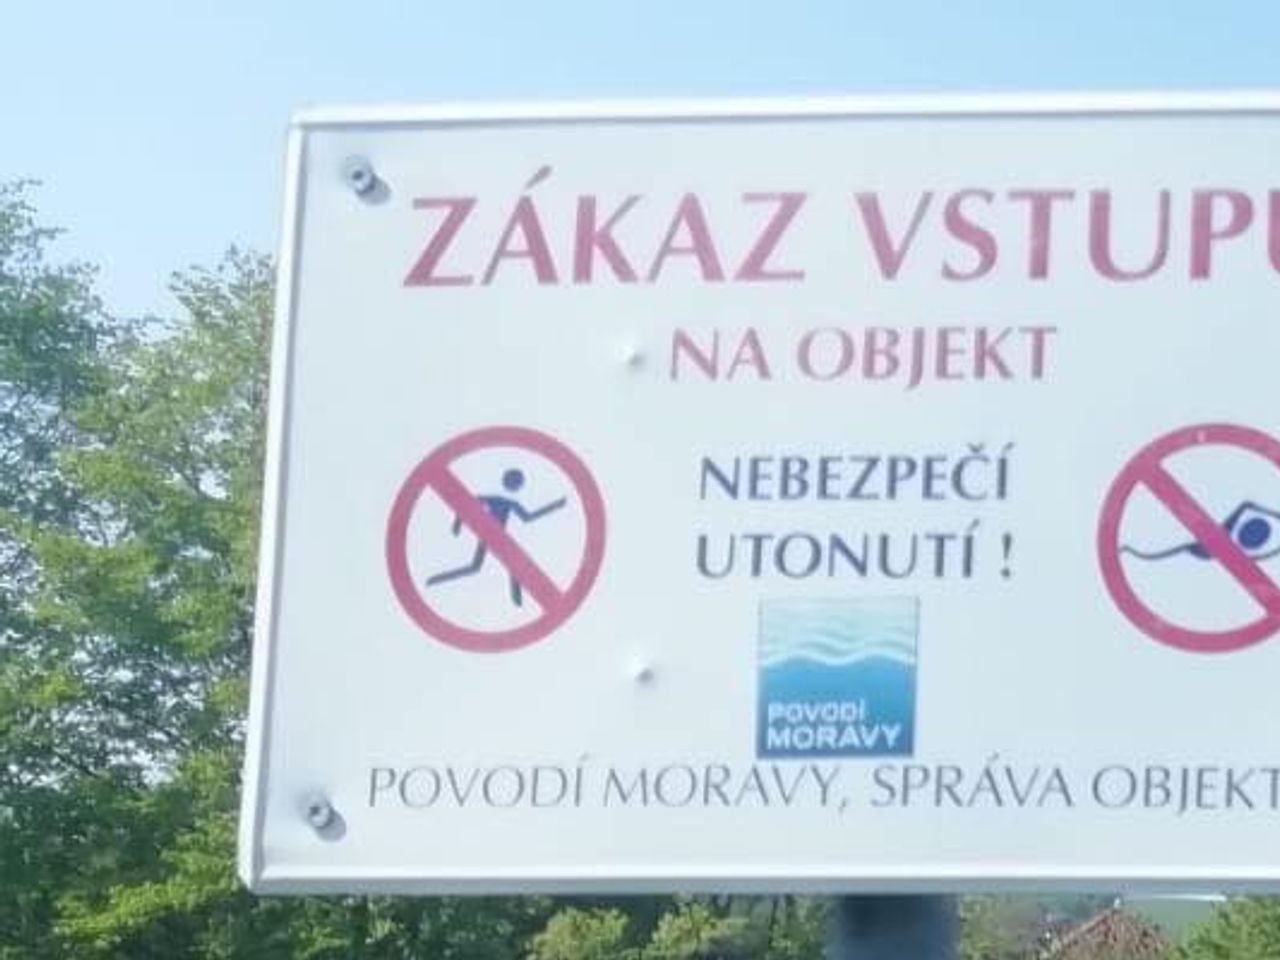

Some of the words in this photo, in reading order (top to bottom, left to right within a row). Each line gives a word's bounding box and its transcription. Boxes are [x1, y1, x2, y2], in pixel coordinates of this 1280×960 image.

[402, 165, 807, 288] ZÁKAZ
[668, 326, 772, 382] NA
[798, 325, 1059, 391] OBJEKT
[699, 440, 1016, 503] NEBEZPEČÍ
[695, 517, 981, 581] UTONUTÍ
[767, 698, 866, 723] POVODÍ
[767, 723, 901, 750] MORAVY
[368, 752, 589, 808] POVODÍ
[602, 763, 849, 815] MORAVY,
[870, 750, 1074, 809] SPRÁVA
